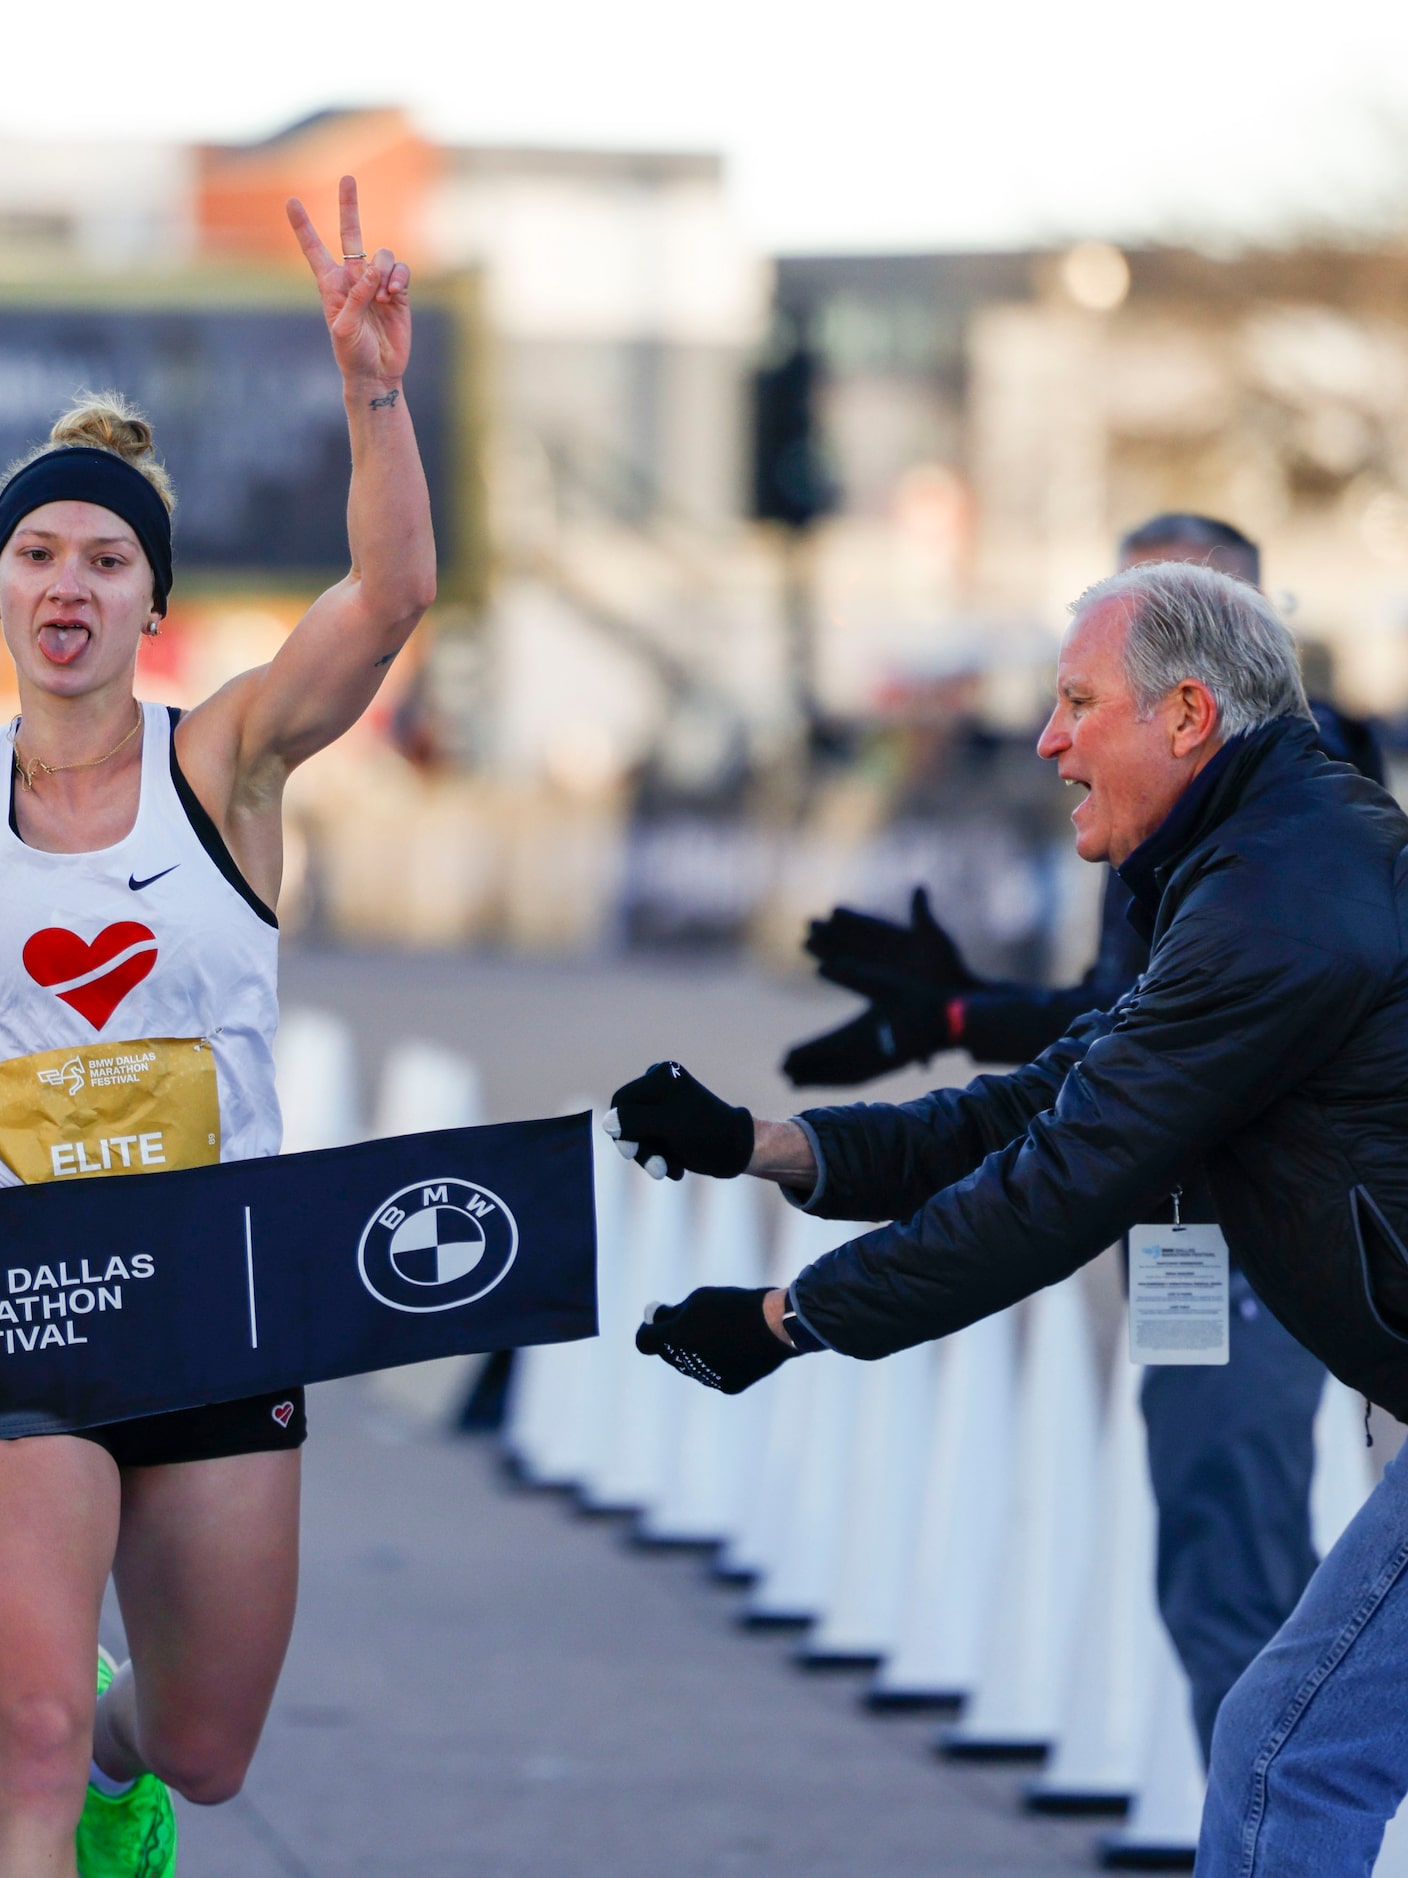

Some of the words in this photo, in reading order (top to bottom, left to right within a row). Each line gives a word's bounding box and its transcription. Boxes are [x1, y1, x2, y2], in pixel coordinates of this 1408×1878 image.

[89, 1058, 114, 1069] BMW
[116, 1052, 156, 1066] DALLAS
[90, 1062, 149, 1078] MARATHON
[91, 1073, 141, 1088] FESTIVAL
[51, 1131, 166, 1177] ELITE
[378, 1185, 496, 1231] BMW
[7, 1253, 156, 1294] DALLAS
